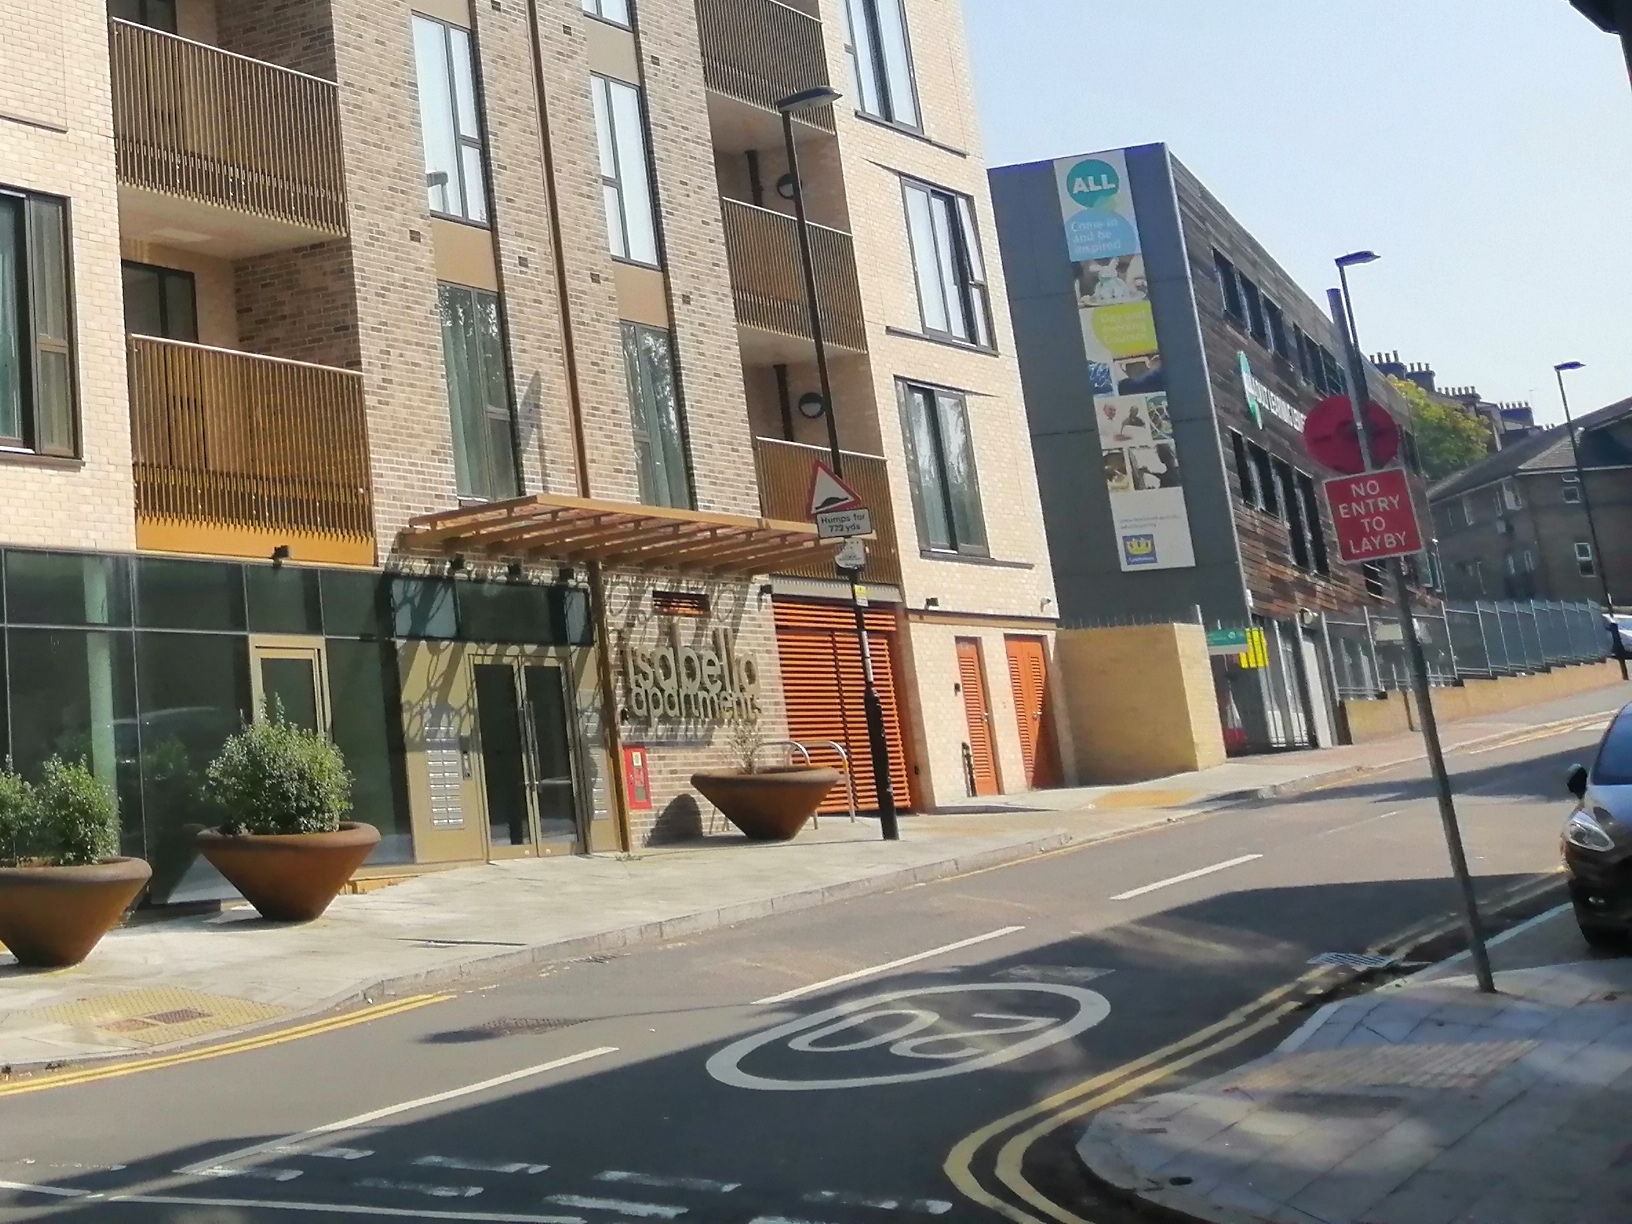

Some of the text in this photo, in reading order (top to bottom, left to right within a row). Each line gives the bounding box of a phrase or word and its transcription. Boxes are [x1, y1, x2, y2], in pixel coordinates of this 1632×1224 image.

[1073, 174, 1116, 194] ALL
[1350, 480, 1380, 498] NO
[1338, 494, 1400, 518] ENTRY
[821, 513, 865, 525] Humps for
[845, 522, 861, 532] yds
[1360, 516, 1386, 534] TO
[1349, 531, 1407, 554] LAYBY
[627, 624, 761, 696] isabella
[787, 1008, 1060, 1060] 20
